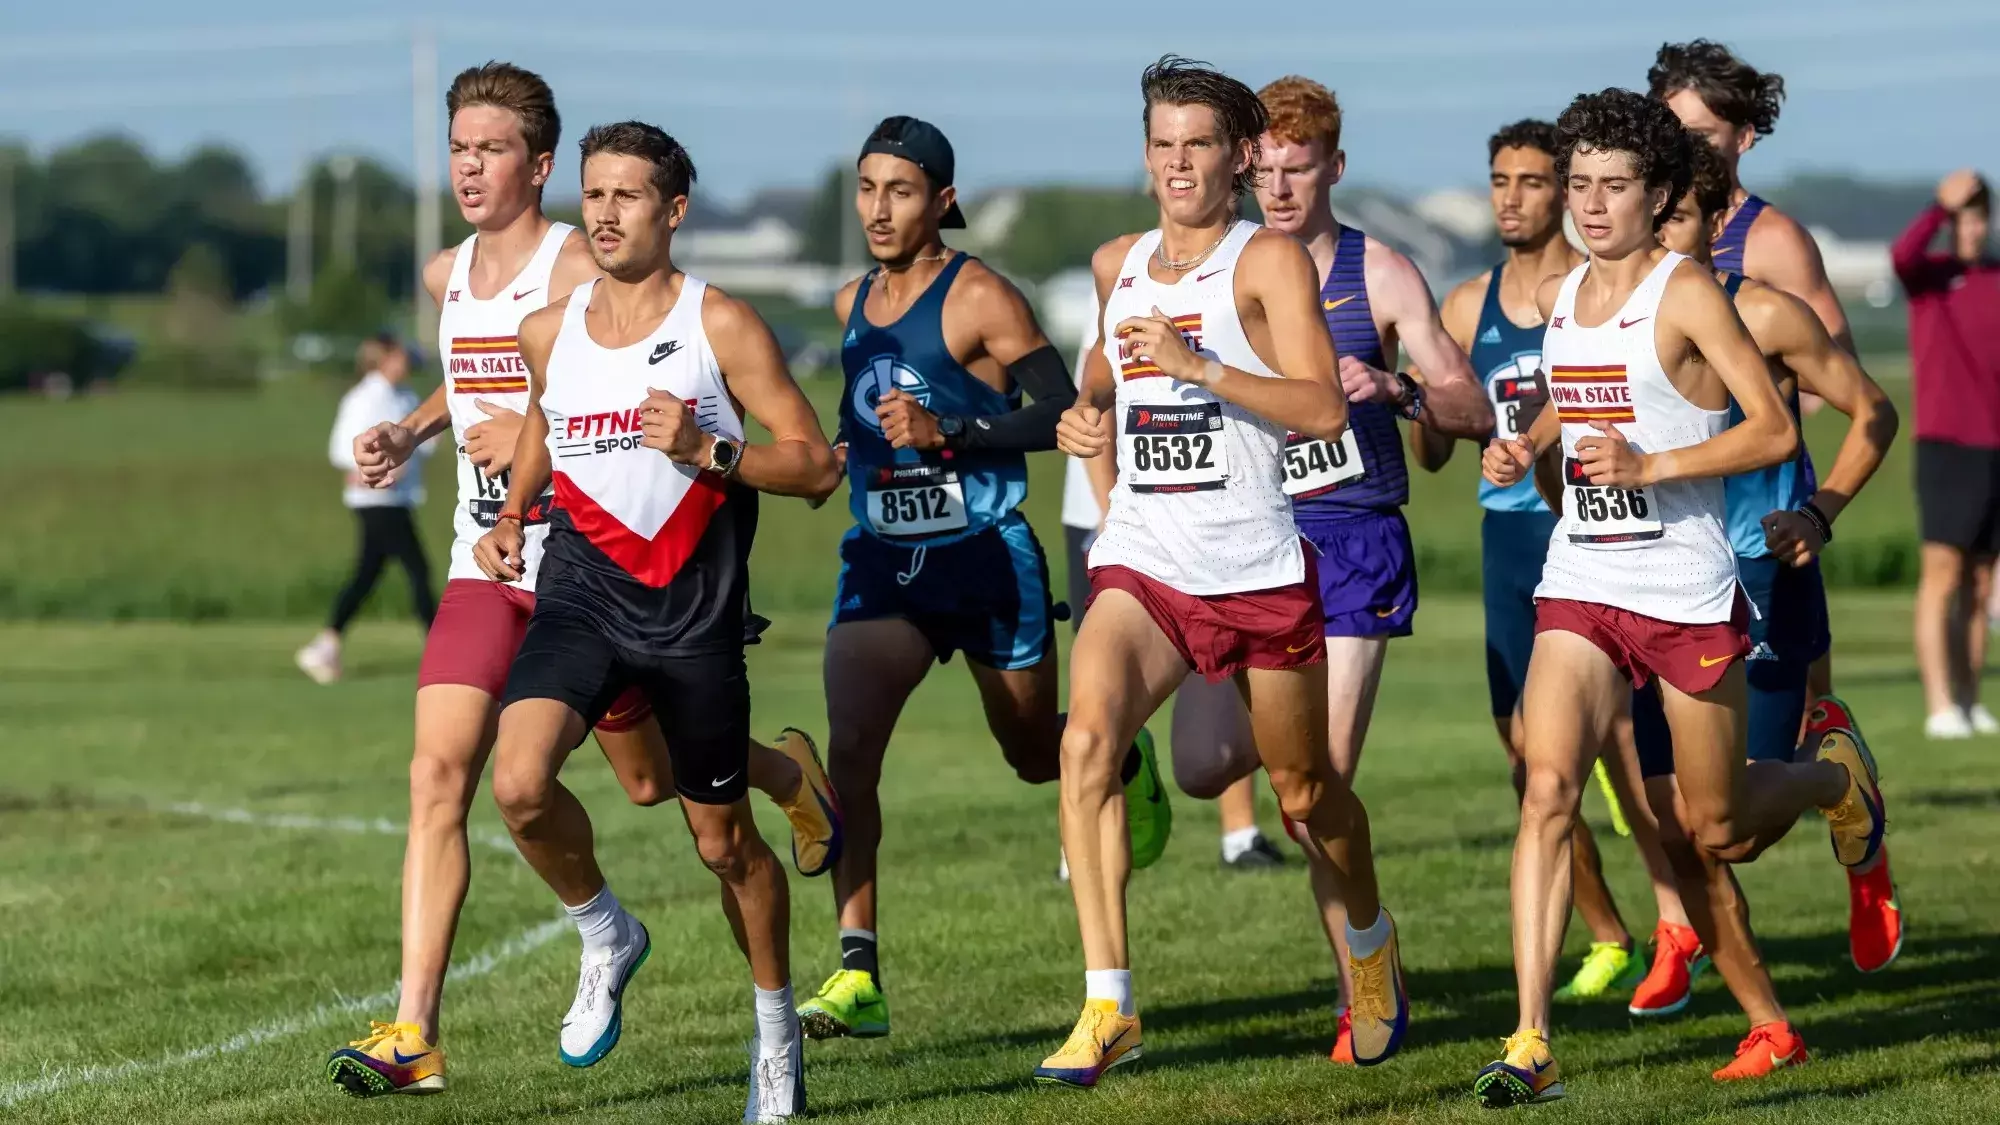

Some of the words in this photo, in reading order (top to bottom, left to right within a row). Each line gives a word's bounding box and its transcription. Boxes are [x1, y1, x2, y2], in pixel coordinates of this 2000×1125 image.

[654, 340, 678, 355] NIKE
[450, 358, 478, 373] IOWA
[481, 356, 525, 373] STATE
[1551, 387, 1582, 403] IOWA
[1585, 387, 1632, 403] STATE
[1152, 412, 1205, 422] PRIMETIME
[1133, 434, 1215, 472] 8532
[881, 488, 951, 524] 8512
[1575, 486, 1649, 522] 8536
